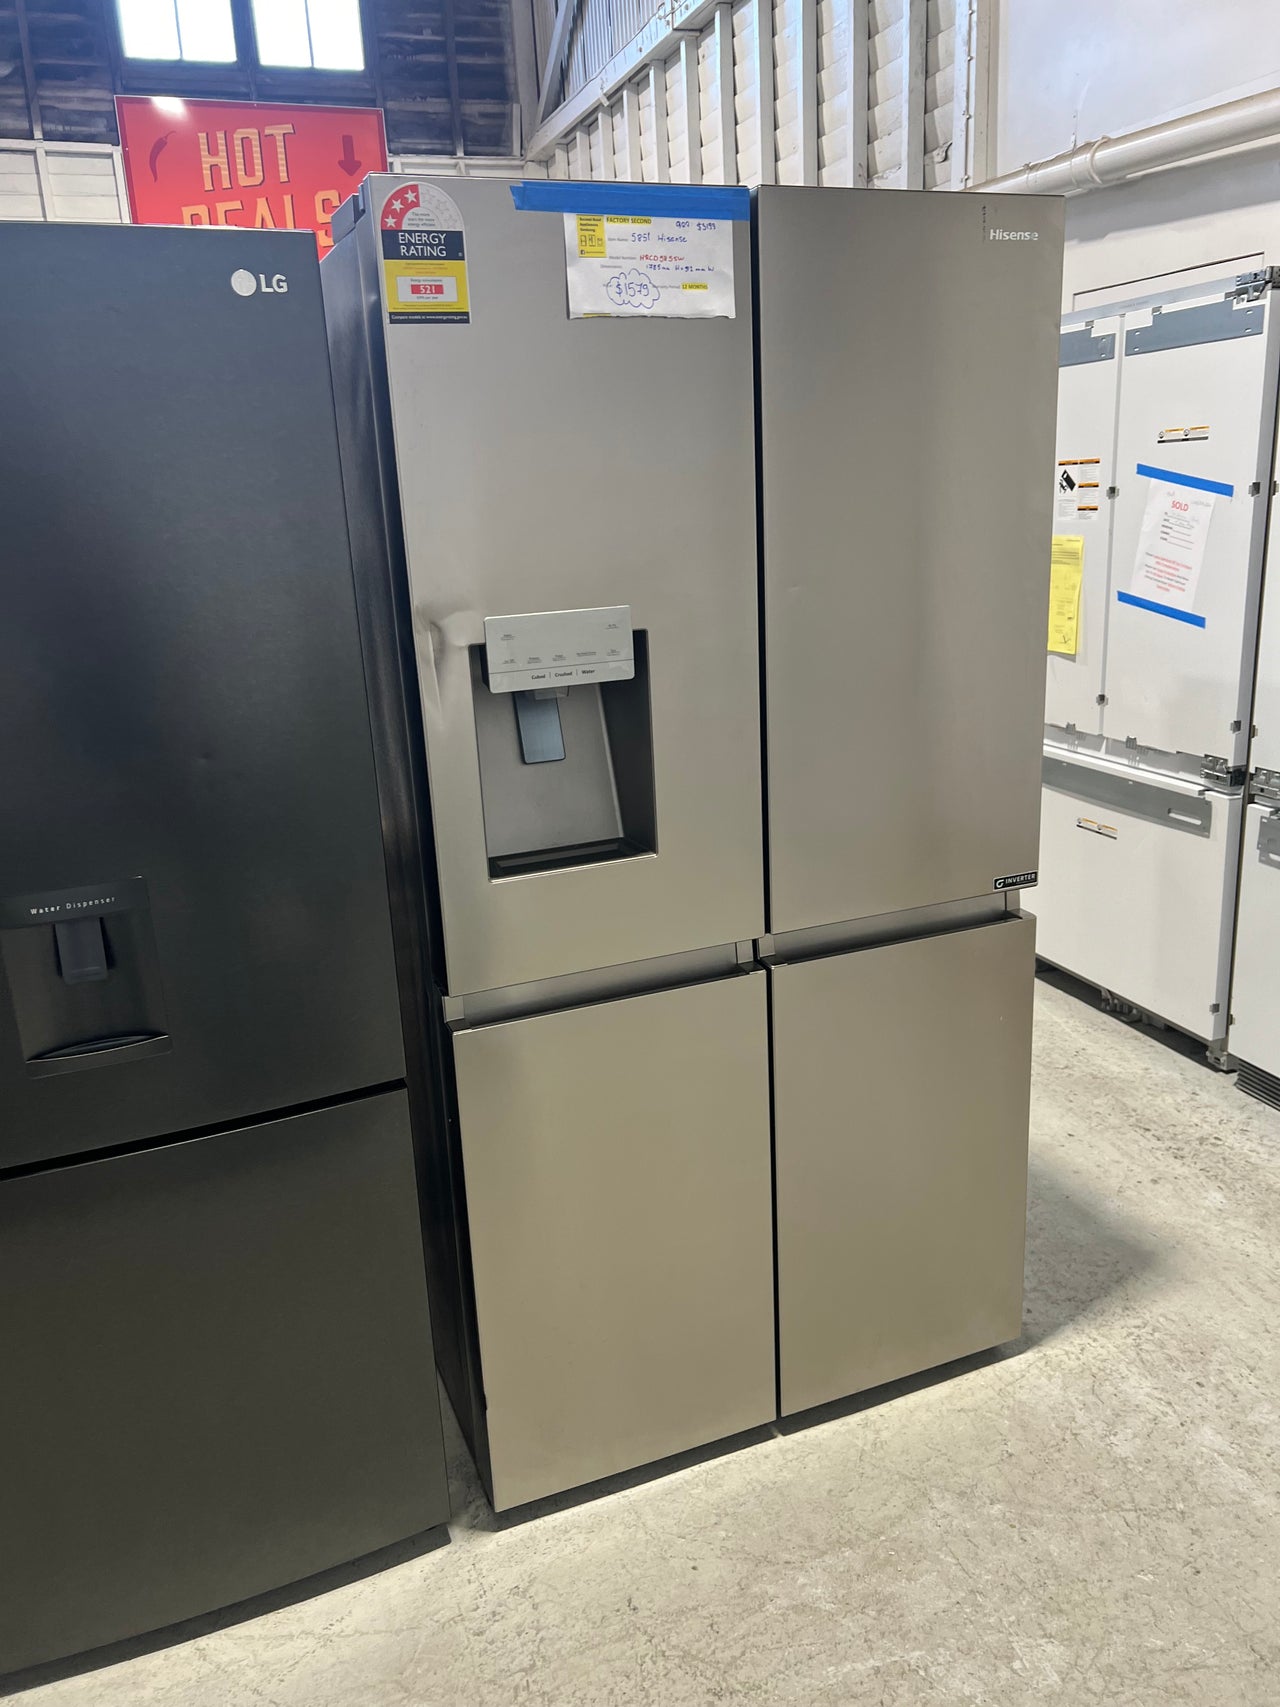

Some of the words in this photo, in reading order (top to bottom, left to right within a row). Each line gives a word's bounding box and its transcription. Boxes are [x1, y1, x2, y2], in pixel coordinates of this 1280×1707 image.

[197, 123, 295, 191] HOT
[398, 232, 447, 244] ENERGY
[657, 233, 688, 243] Hisense
[989, 228, 1039, 241] Hisense
[400, 245, 447, 257] RATING
[258, 274, 288, 293] LG
[419, 285, 436, 294] 521
[615, 281, 650, 298] $1579
[1171, 500, 1189, 512] SOLD
[1005, 873, 1036, 884] INVERTER
[30, 904, 61, 915] Water
[66, 896, 116, 910] Dispenser
